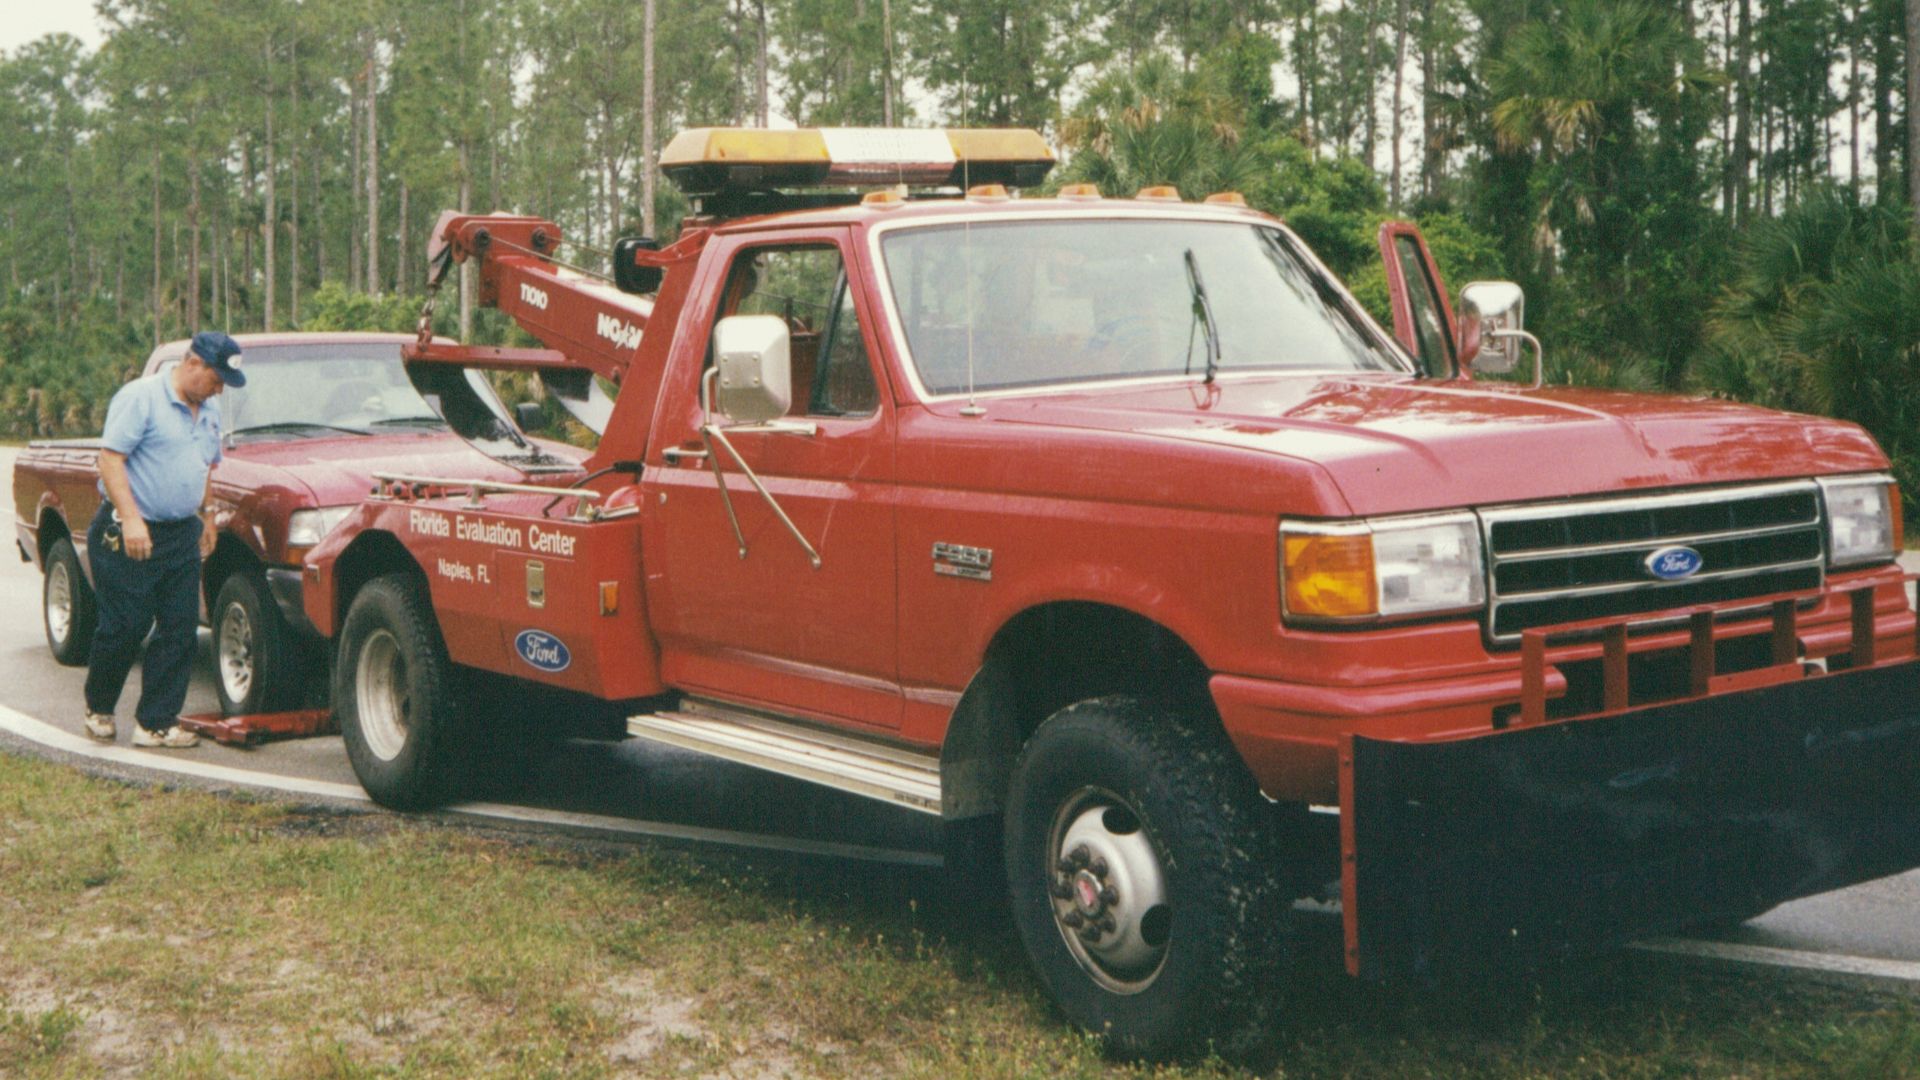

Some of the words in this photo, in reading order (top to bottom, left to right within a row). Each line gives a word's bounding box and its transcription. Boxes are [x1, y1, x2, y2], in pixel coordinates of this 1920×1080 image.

[410, 509, 450, 537] Florida
[456, 515, 522, 548] Evaluation
[528, 524, 576, 556] Center
[438, 558, 474, 584] Naples,
[477, 564, 491, 584] FL
[526, 633, 560, 664] Ford
